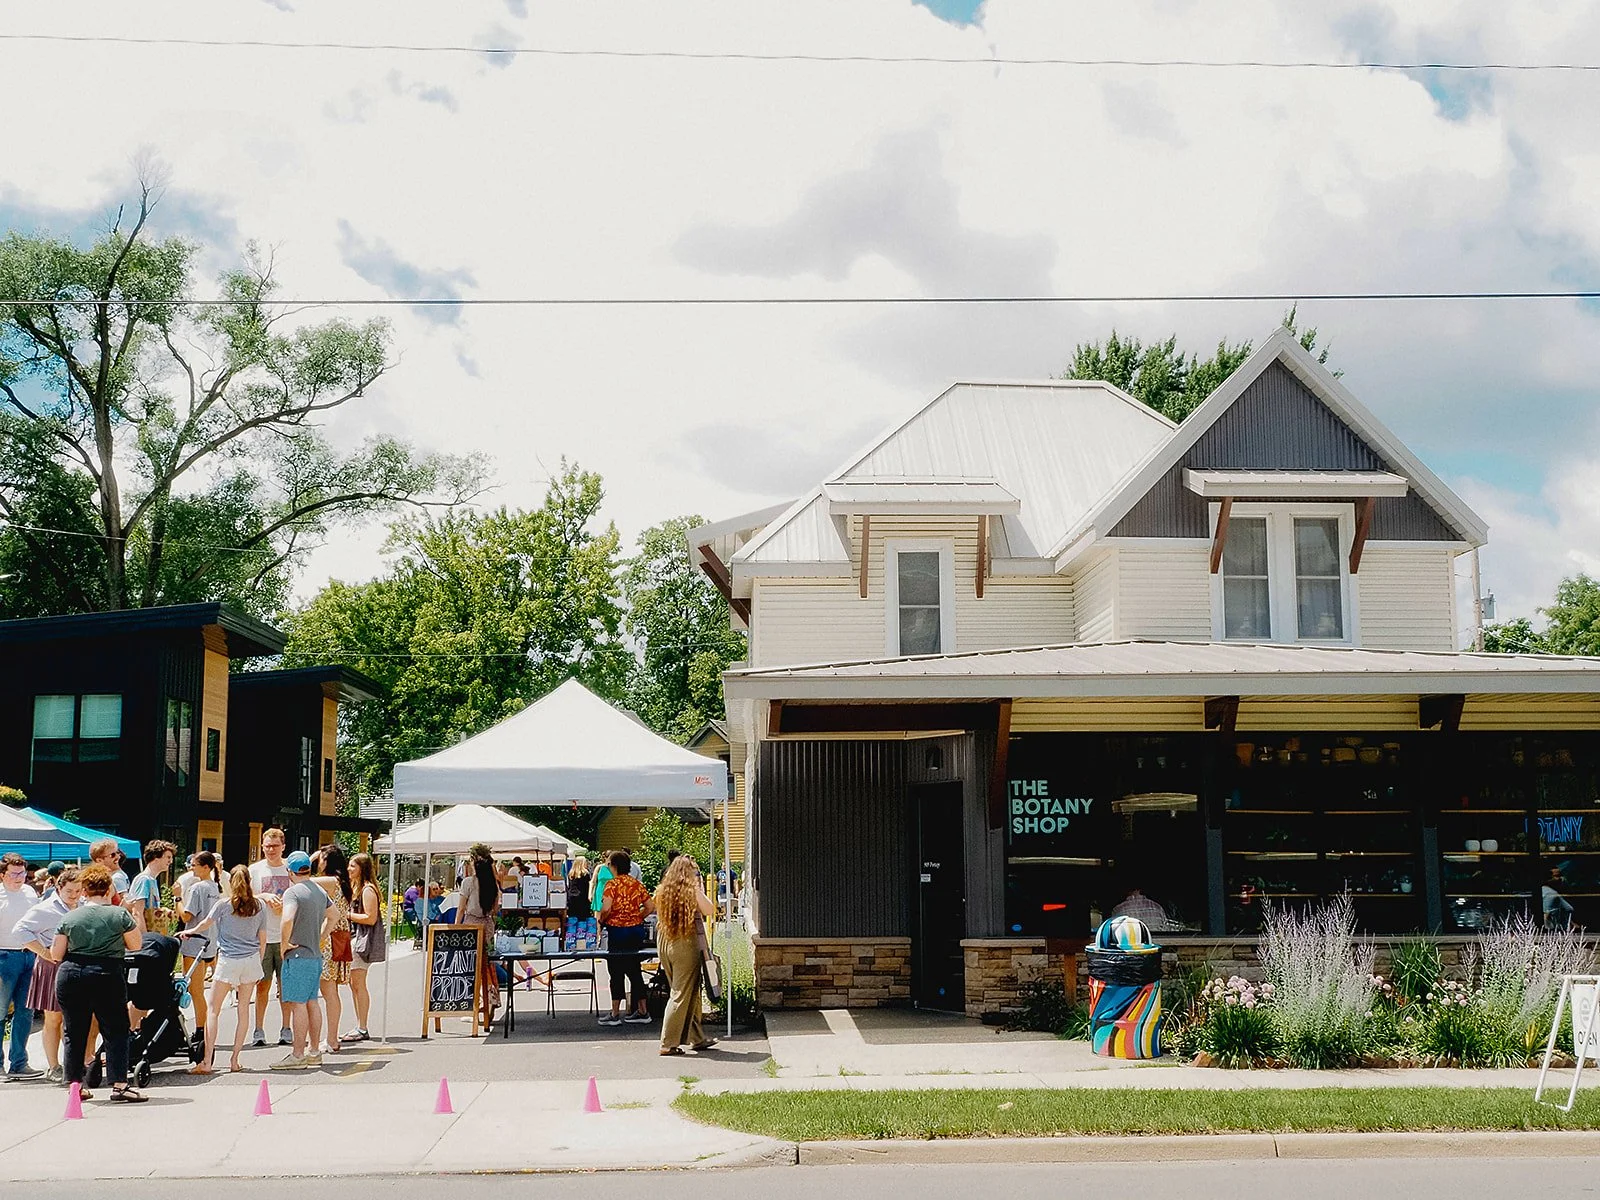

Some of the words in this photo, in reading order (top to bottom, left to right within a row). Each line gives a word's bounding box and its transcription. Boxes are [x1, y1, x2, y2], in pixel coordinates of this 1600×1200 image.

[1011, 780, 1048, 796] THE
[1012, 798, 1093, 815] BOTANY
[1013, 817, 1069, 834] SHOP
[432, 950, 477, 974] PLANT
[430, 976, 474, 1001] PRIDE
[1578, 1031, 1598, 1046] OEN
